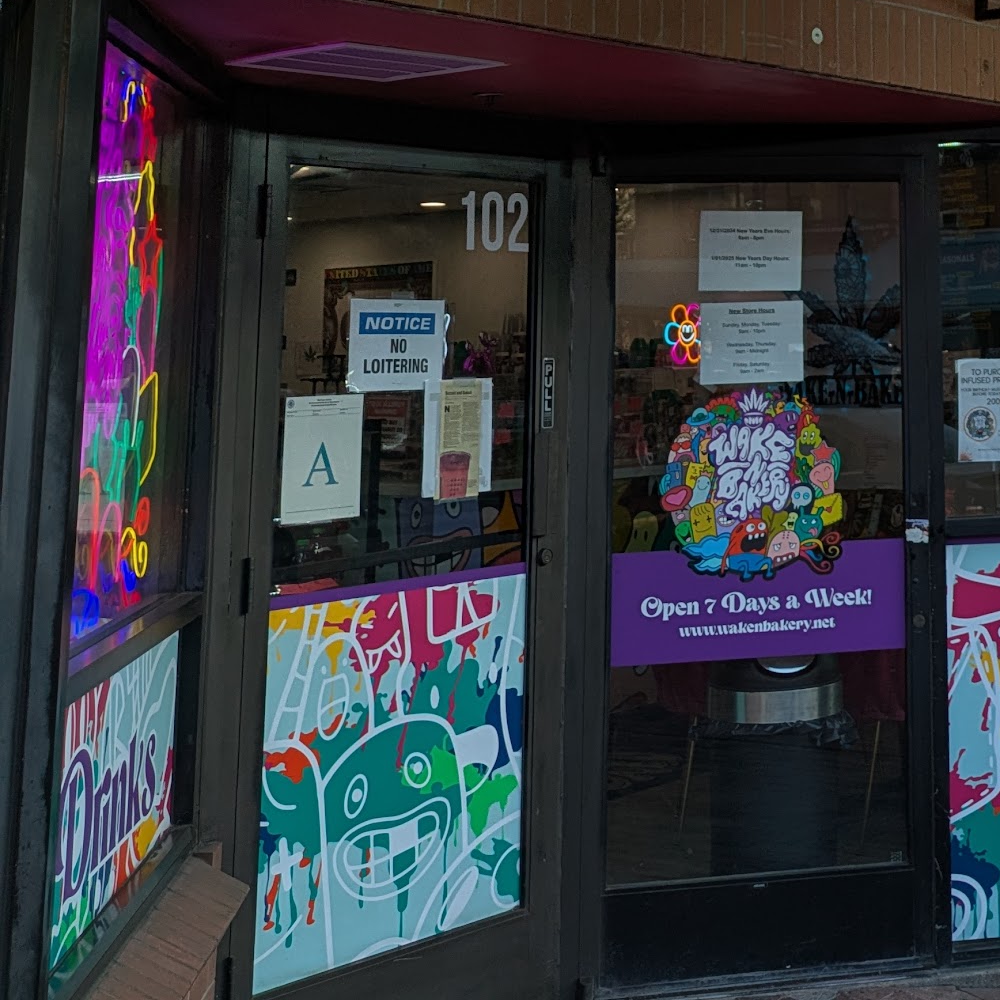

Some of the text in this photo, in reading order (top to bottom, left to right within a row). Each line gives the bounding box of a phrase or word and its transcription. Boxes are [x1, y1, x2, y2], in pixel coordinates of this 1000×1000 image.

[461, 190, 529, 253] 102
[364, 316, 432, 331] NOTICE
[390, 338, 407, 354] NO
[363, 358, 429, 374] LOITERING
[971, 368, 982, 376] TO
[544, 364, 553, 412] PULL
[961, 376, 991, 384] INFUSED
[708, 422, 797, 465] WAKE
[301, 441, 339, 487] A
[640, 588, 873, 621] Open 7 Days a Week!
[678, 616, 836, 638] www.wakenbakery.net
